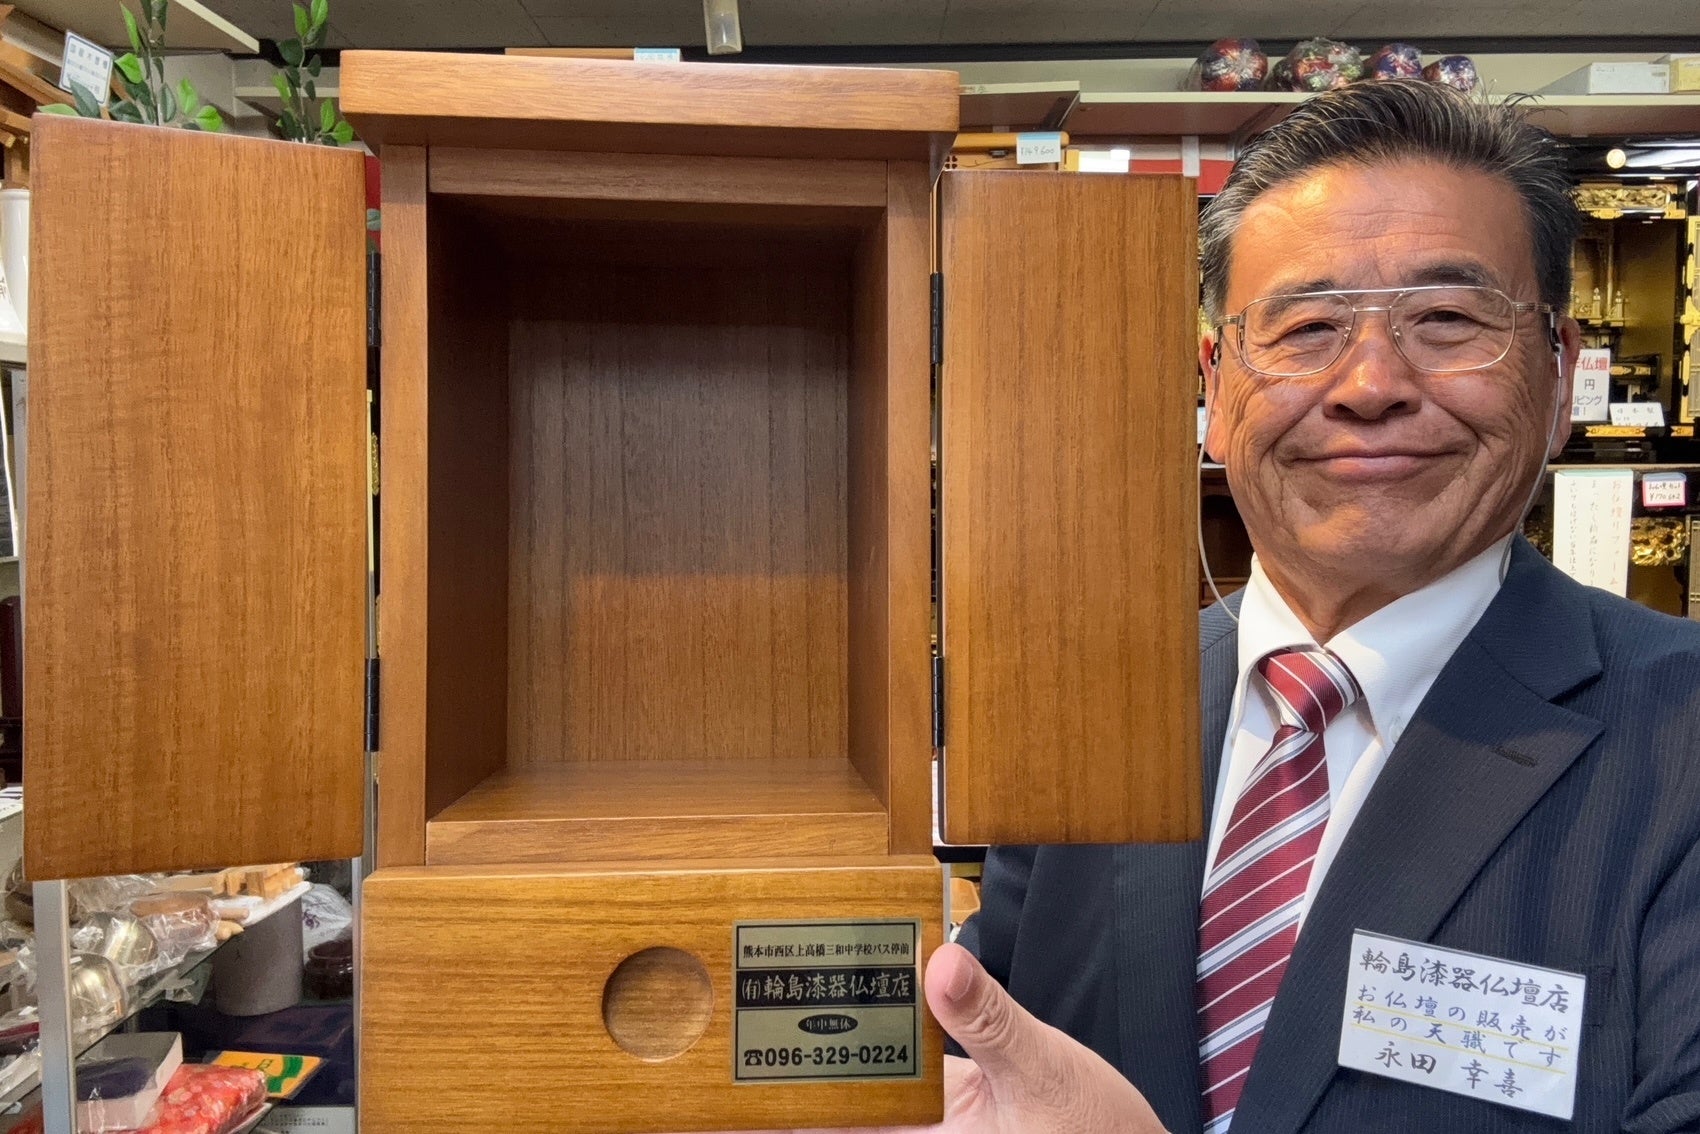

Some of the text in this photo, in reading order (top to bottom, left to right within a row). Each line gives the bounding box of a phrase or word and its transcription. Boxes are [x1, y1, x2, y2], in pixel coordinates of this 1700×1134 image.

[1584, 378, 1595, 390] 円
[1359, 948, 1570, 1014] 輪島漆器仏壇店
[806, 1018, 851, 1030] 年中無休
[1357, 984, 1568, 1042] お仏壇の販売が
[765, 1045, 908, 1066] 096-329-0224
[1352, 1006, 1562, 1067] 私の天職です
